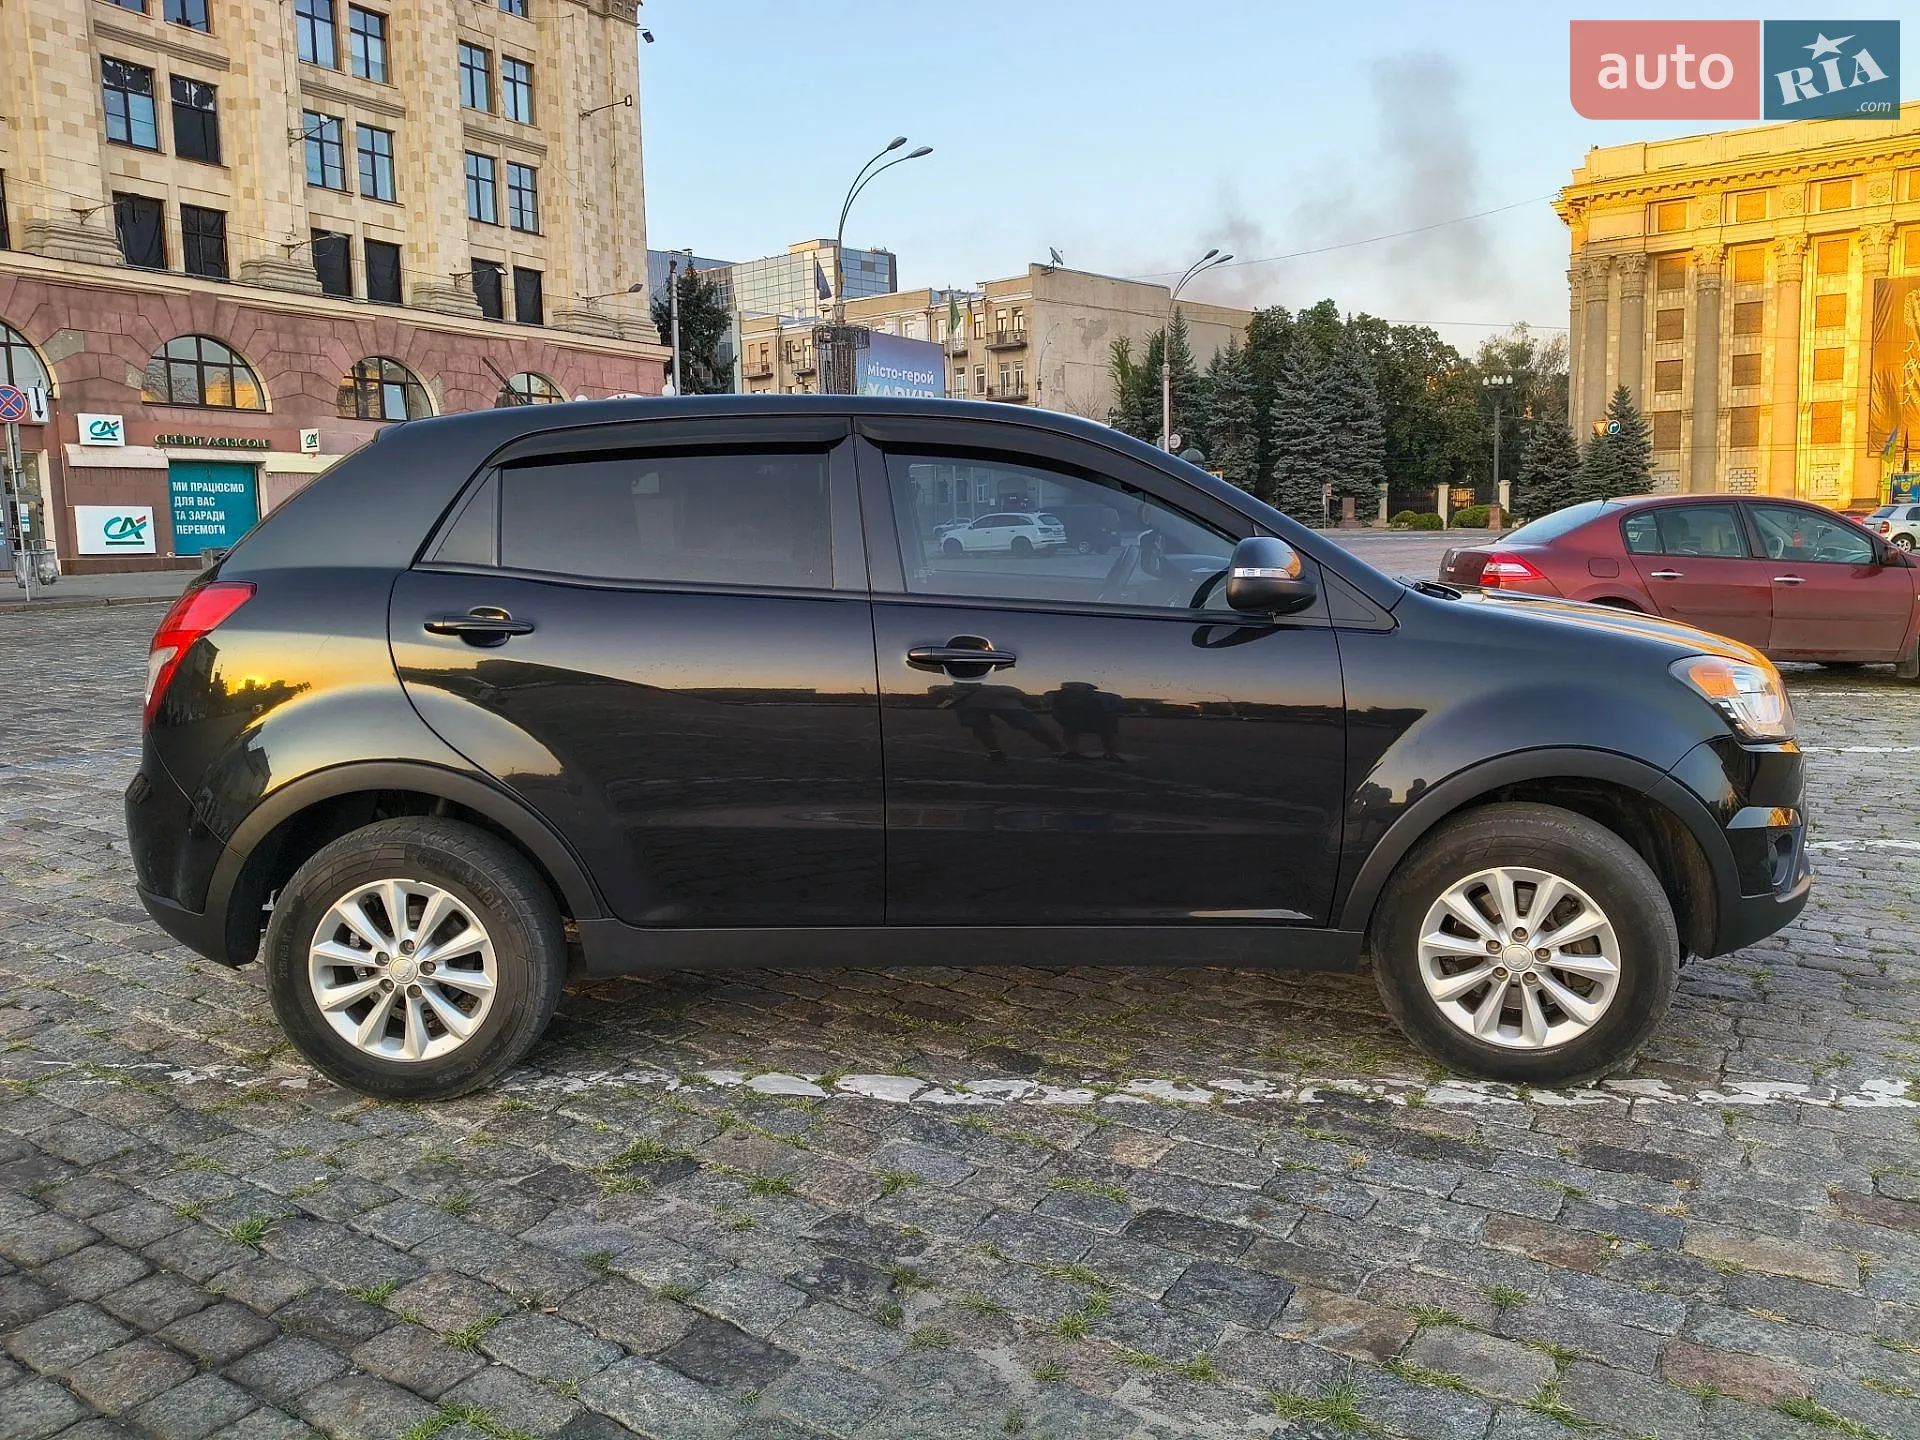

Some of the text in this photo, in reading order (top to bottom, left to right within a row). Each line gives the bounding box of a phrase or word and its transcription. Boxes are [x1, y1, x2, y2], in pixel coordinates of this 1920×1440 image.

[207, 436, 271, 448] AGRICOLE
[172, 481, 245, 494] МИ ПРАЦЮЄМО
[174, 495, 216, 508] ДЛЯ ВАС
[174, 510, 226, 522] ТА ЗАРАДИ
[176, 524, 226, 535] ПЕРЕМОГИ
